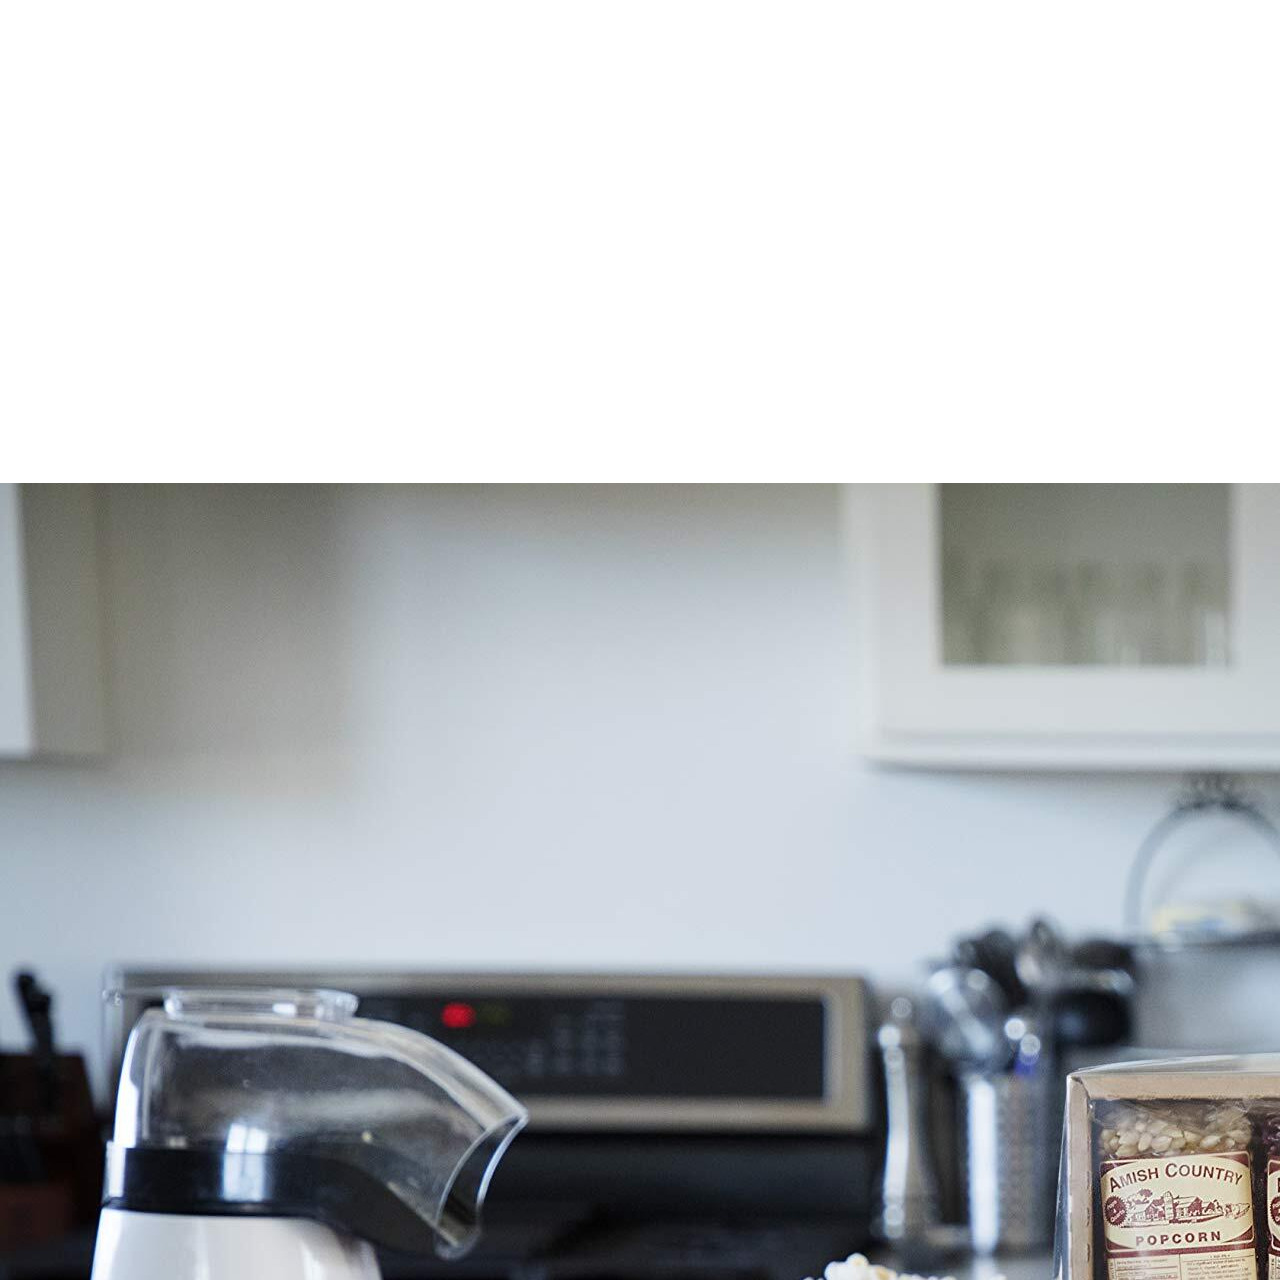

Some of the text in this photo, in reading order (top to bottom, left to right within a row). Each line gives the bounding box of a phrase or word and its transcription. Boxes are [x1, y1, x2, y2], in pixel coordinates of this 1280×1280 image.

[1110, 1163, 1243, 1192] AMISH COUNTRY
[1136, 1231, 1221, 1246] POPCORN
